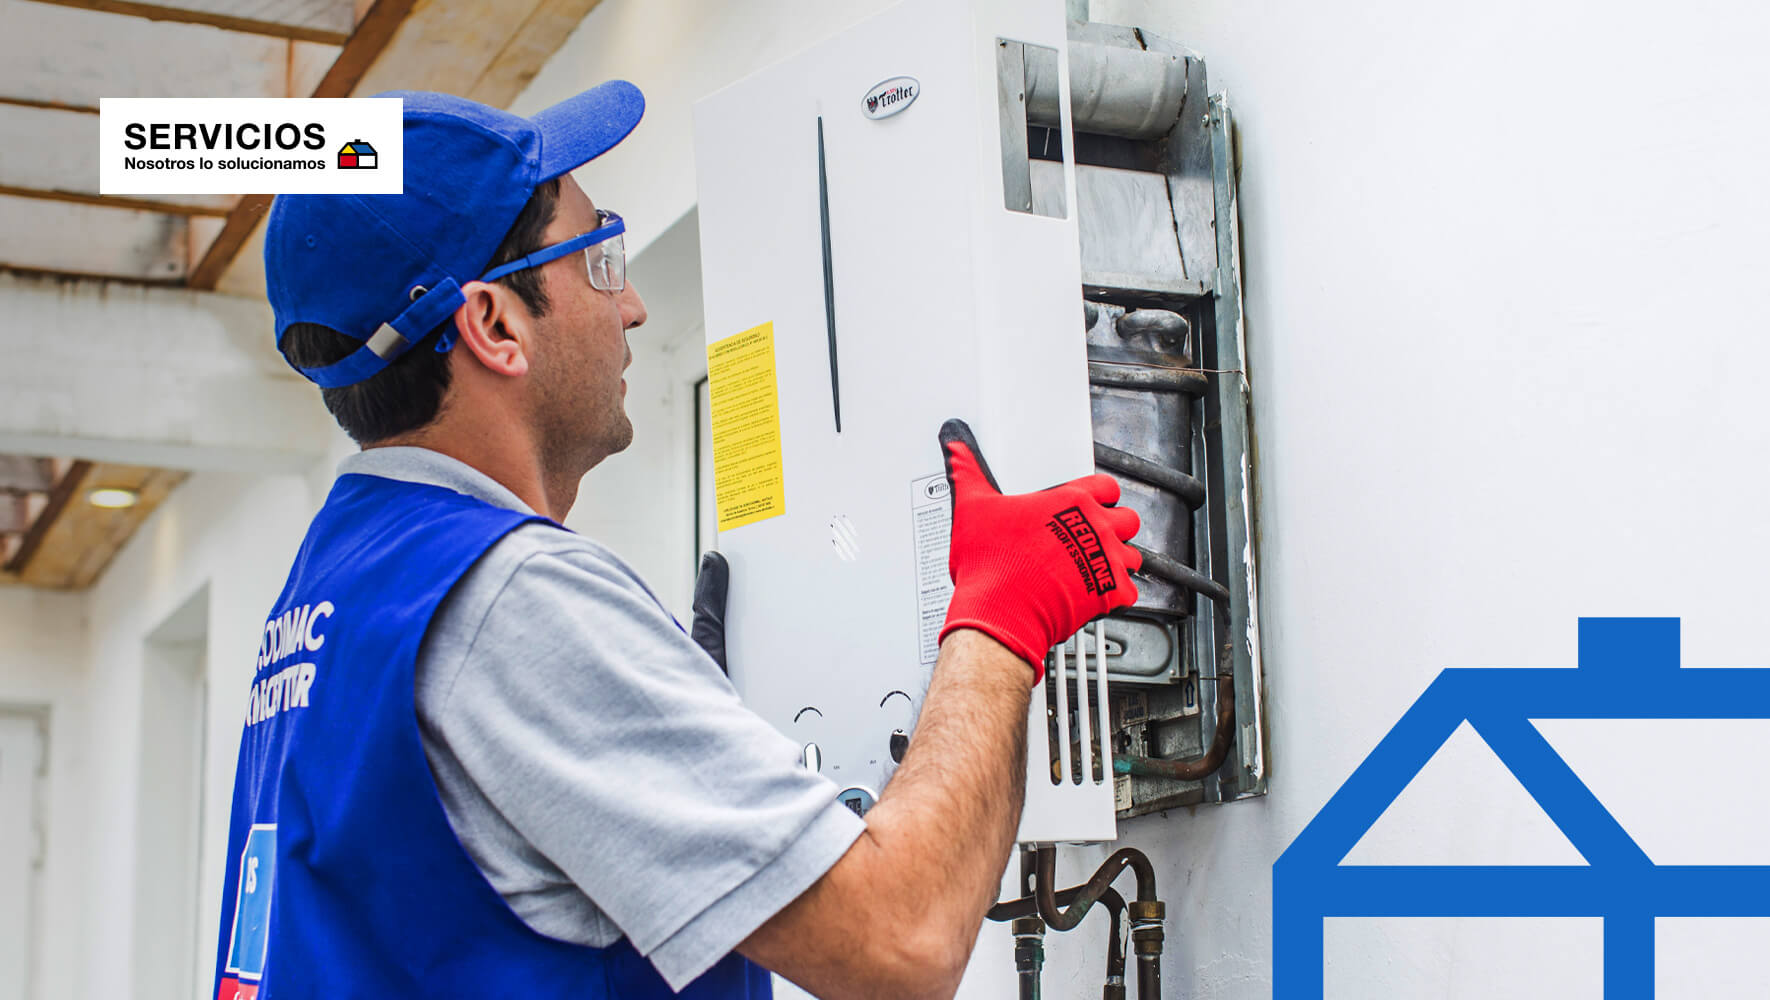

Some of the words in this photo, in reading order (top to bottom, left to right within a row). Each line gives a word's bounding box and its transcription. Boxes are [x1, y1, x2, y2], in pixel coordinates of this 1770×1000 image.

[879, 86, 913, 107] Trotter
[1045, 520, 1096, 595] PROFESSIONAL
[1059, 509, 1114, 593] REDLINE
[258, 600, 335, 671] ODIMAC
